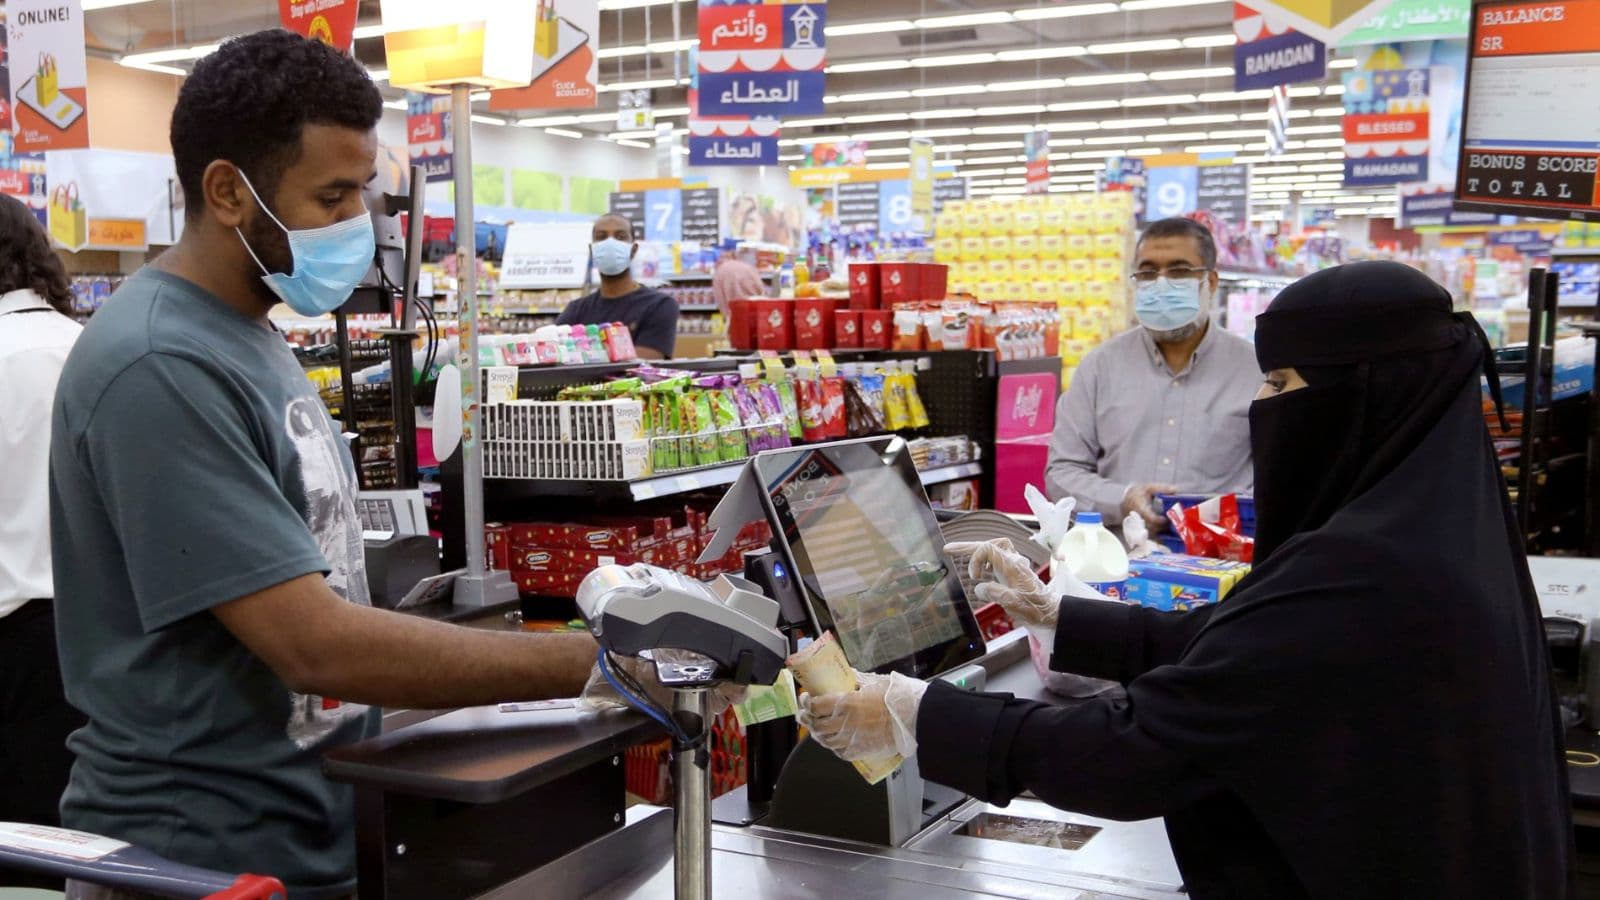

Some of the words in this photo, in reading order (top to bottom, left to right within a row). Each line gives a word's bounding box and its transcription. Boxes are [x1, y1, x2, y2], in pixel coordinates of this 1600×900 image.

[18, 7, 70, 26] ONLINE!
[1482, 6, 1565, 27] BALANCE
[711, 9, 767, 46] وأنتم
[1480, 36, 1504, 51] SR
[1245, 42, 1315, 76] RAMADAN
[720, 79, 799, 104] العطاء
[1357, 120, 1416, 135] BLESSED
[704, 141, 762, 159] العطاء
[1353, 162, 1419, 178] RAMADAN
[1468, 153, 1526, 170] BONUS
[1537, 156, 1599, 174] SCORE
[887, 194, 912, 226] 8
[1158, 181, 1186, 218] 9
[652, 202, 674, 233] 7
[1548, 584, 1569, 593] STC
